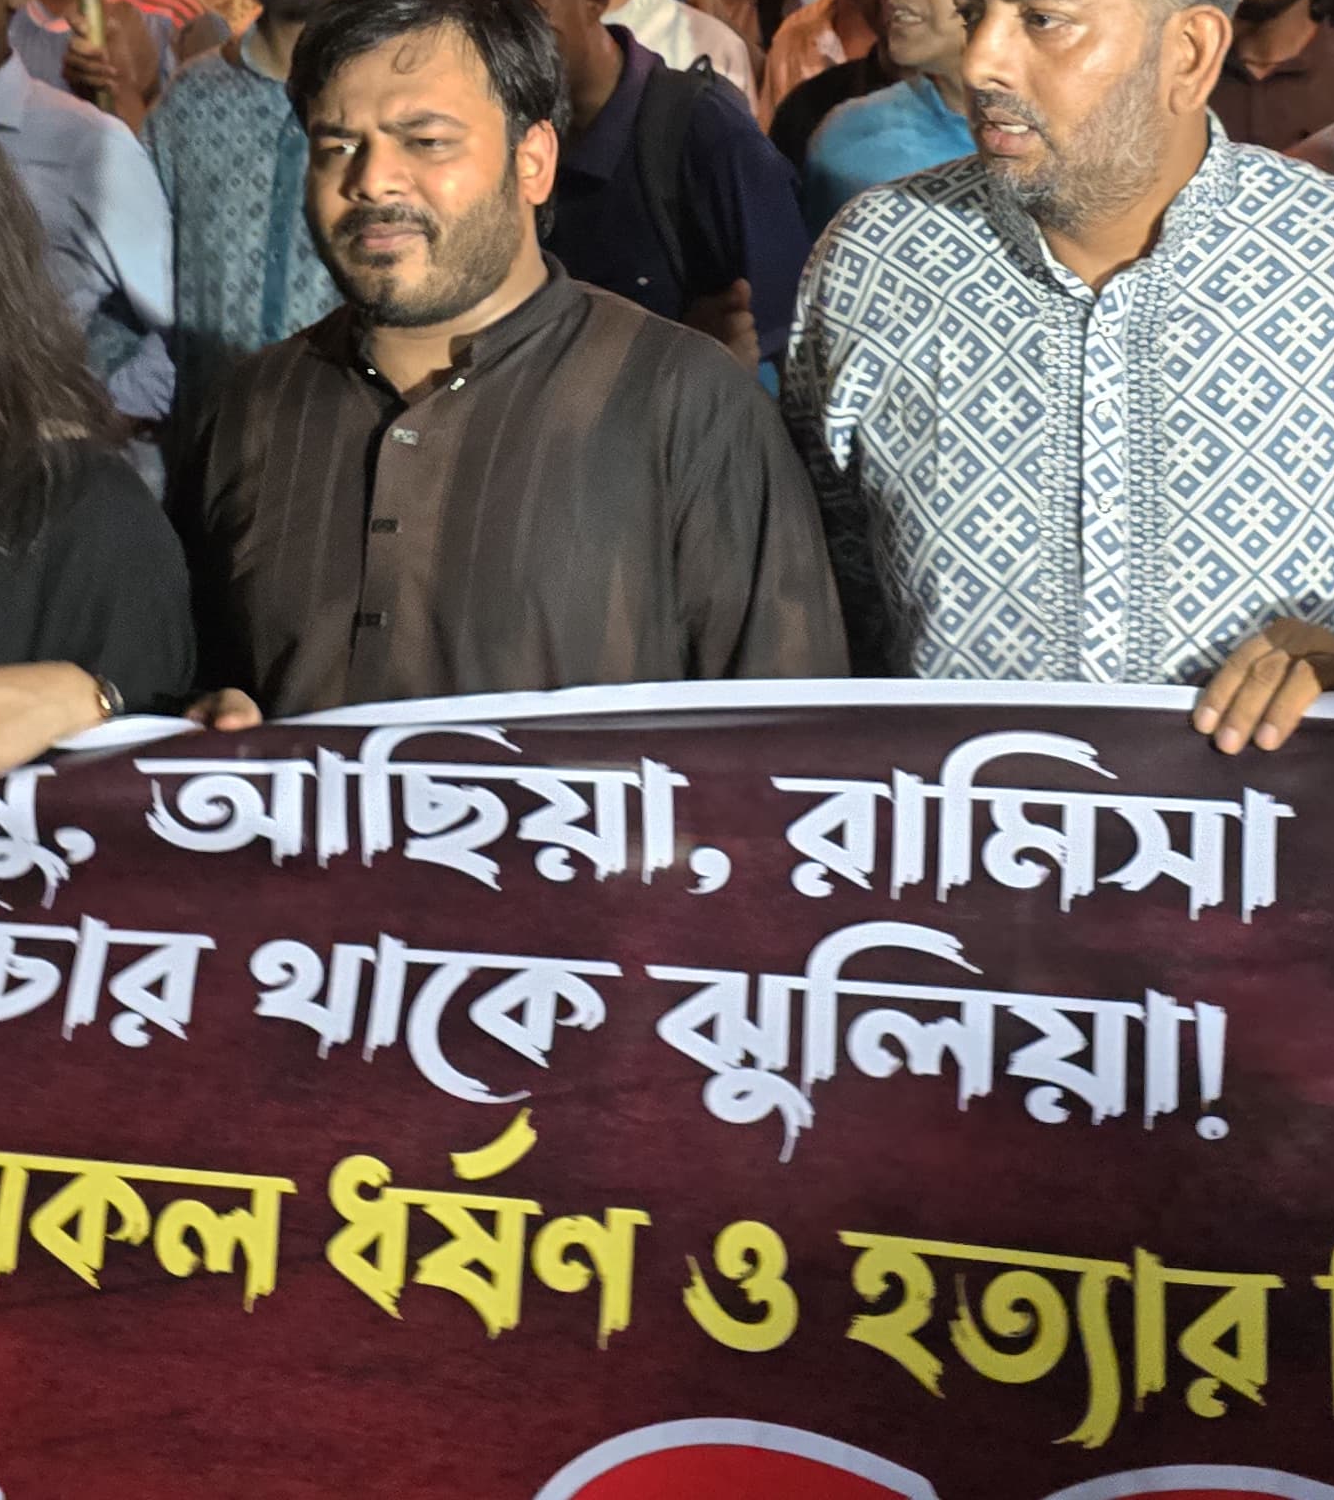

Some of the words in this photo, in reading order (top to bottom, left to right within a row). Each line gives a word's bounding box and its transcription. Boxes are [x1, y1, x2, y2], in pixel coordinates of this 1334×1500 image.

[134, 724, 732, 894] আছিয়া,
[771, 731, 1297, 924] রামিসা
[249, 933, 624, 1104] থাকে
[644, 921, 1229, 1162] ঝুলিয়া!
[325, 1108, 651, 1349] ধর্ষণ
[682, 1219, 800, 1352] ও
[839, 1230, 1285, 1450] হত্যার
